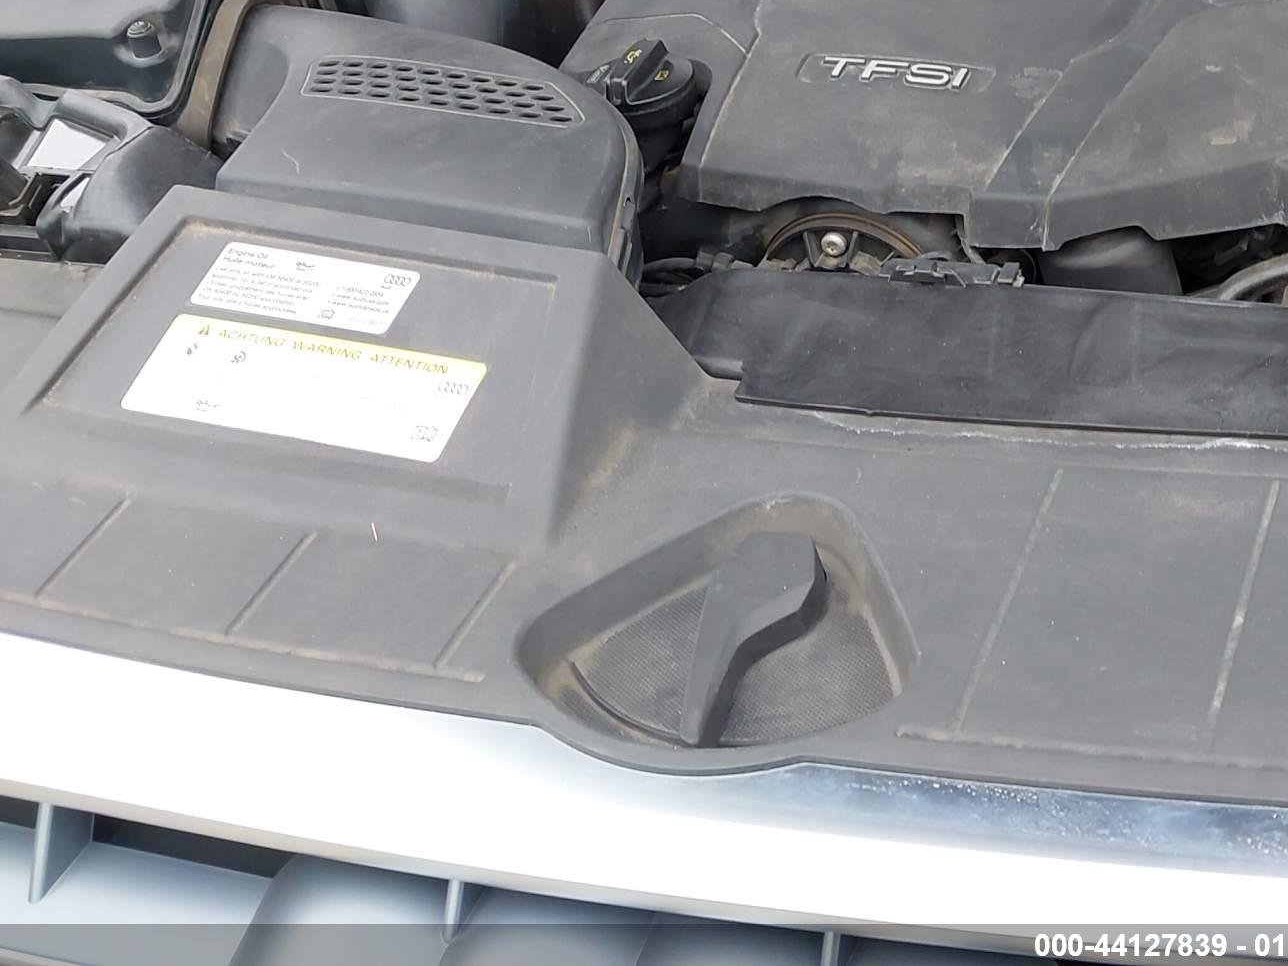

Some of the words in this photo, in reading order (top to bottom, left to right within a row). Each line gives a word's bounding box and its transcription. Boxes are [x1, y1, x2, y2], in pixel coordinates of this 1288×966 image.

[822, 55, 971, 90] TFSI
[217, 328, 286, 347] ACHTUNG
[292, 341, 362, 360] WARNING
[370, 352, 449, 374] ATTENTION
